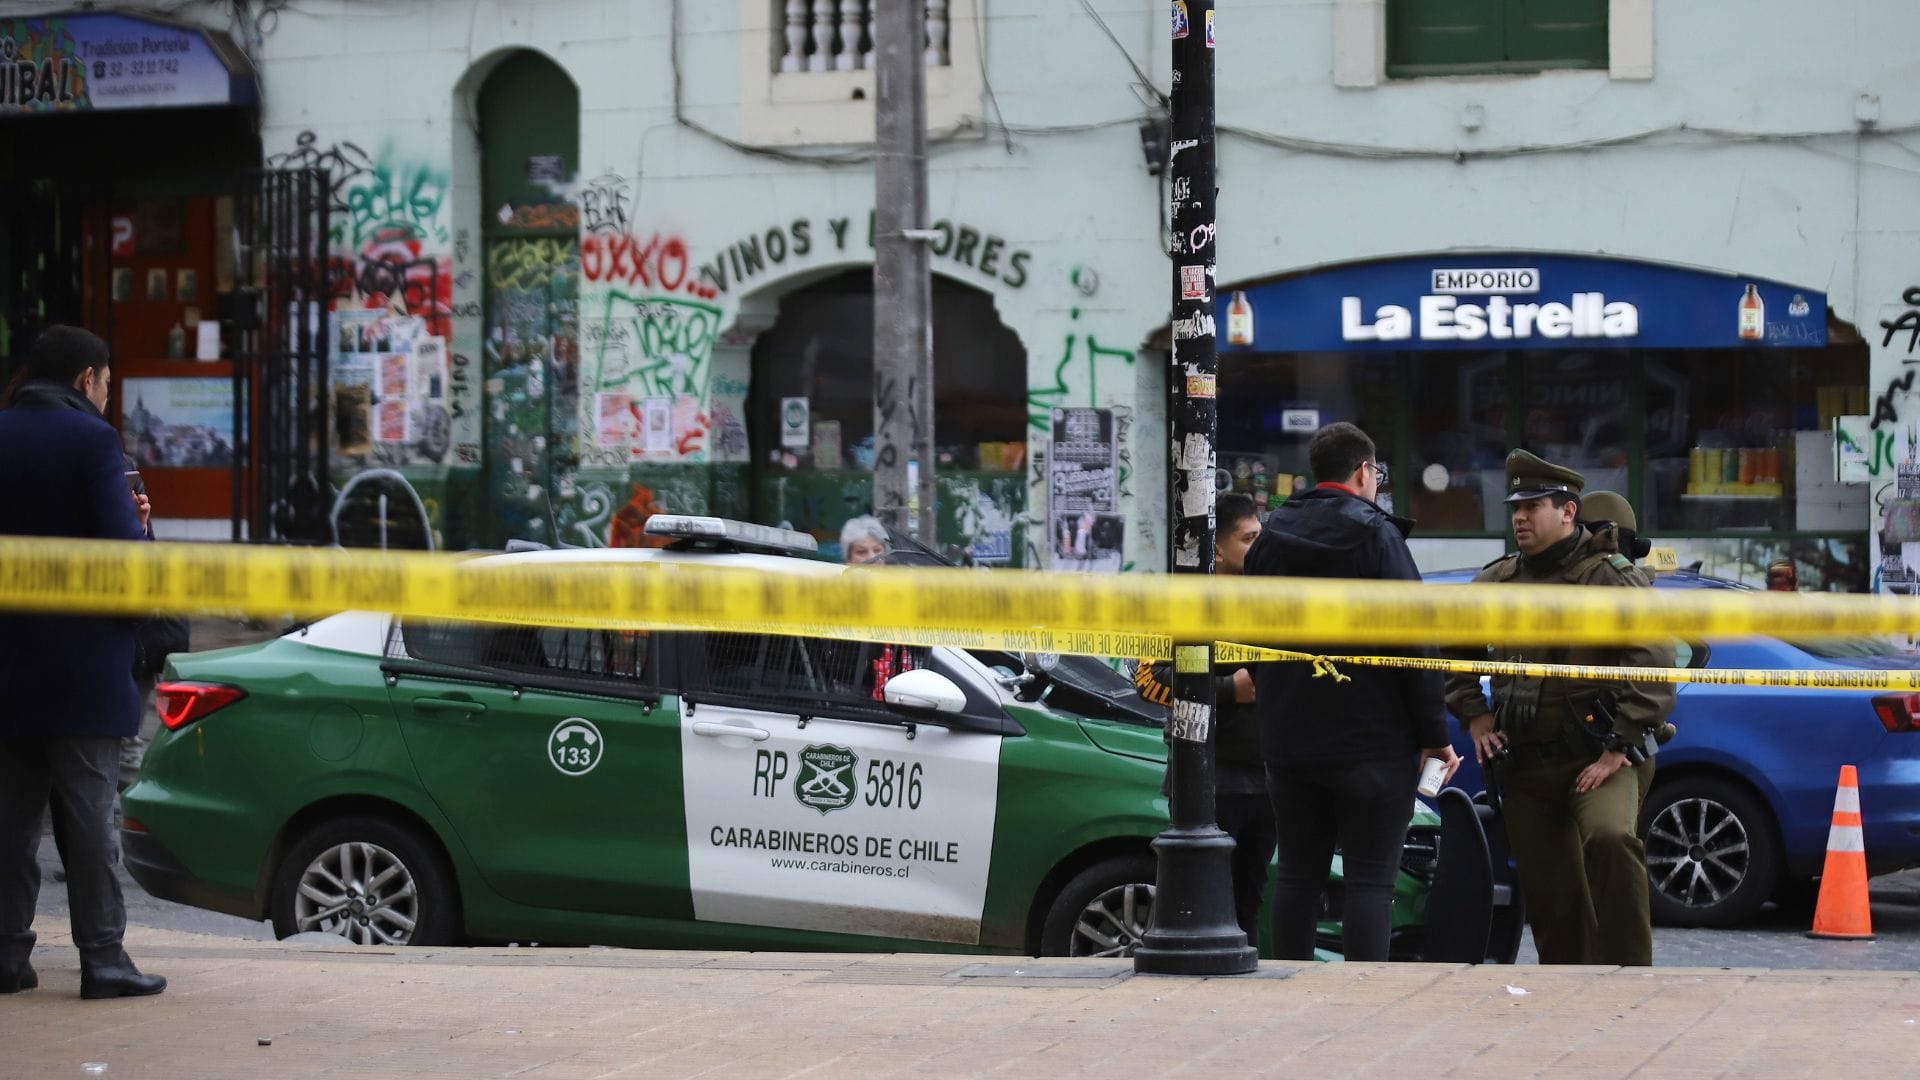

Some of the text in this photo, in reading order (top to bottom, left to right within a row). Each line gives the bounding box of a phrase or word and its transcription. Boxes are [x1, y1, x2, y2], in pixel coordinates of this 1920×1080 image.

[700, 217, 812, 294] VINOS
[828, 217, 851, 250] Y
[1434, 271, 1534, 290] EMPORIO
[1341, 291, 1639, 341] La Estrella
[1689, 670, 1728, 684] PASAR
[1731, 670, 1745, 685] NO
[1761, 670, 1791, 686] CHILE
[1795, 670, 1808, 687] DE
[1812, 670, 1888, 688] CARABINEROS
[557, 746, 591, 766] 133
[805, 752, 851, 763] CARABINEROS DE
[819, 760, 836, 768] CHILE
[753, 749, 923, 810] RP 5816
[710, 825, 960, 863] CARABINEROS DE CHILE
[771, 856, 910, 879] www.carabineros.cl
